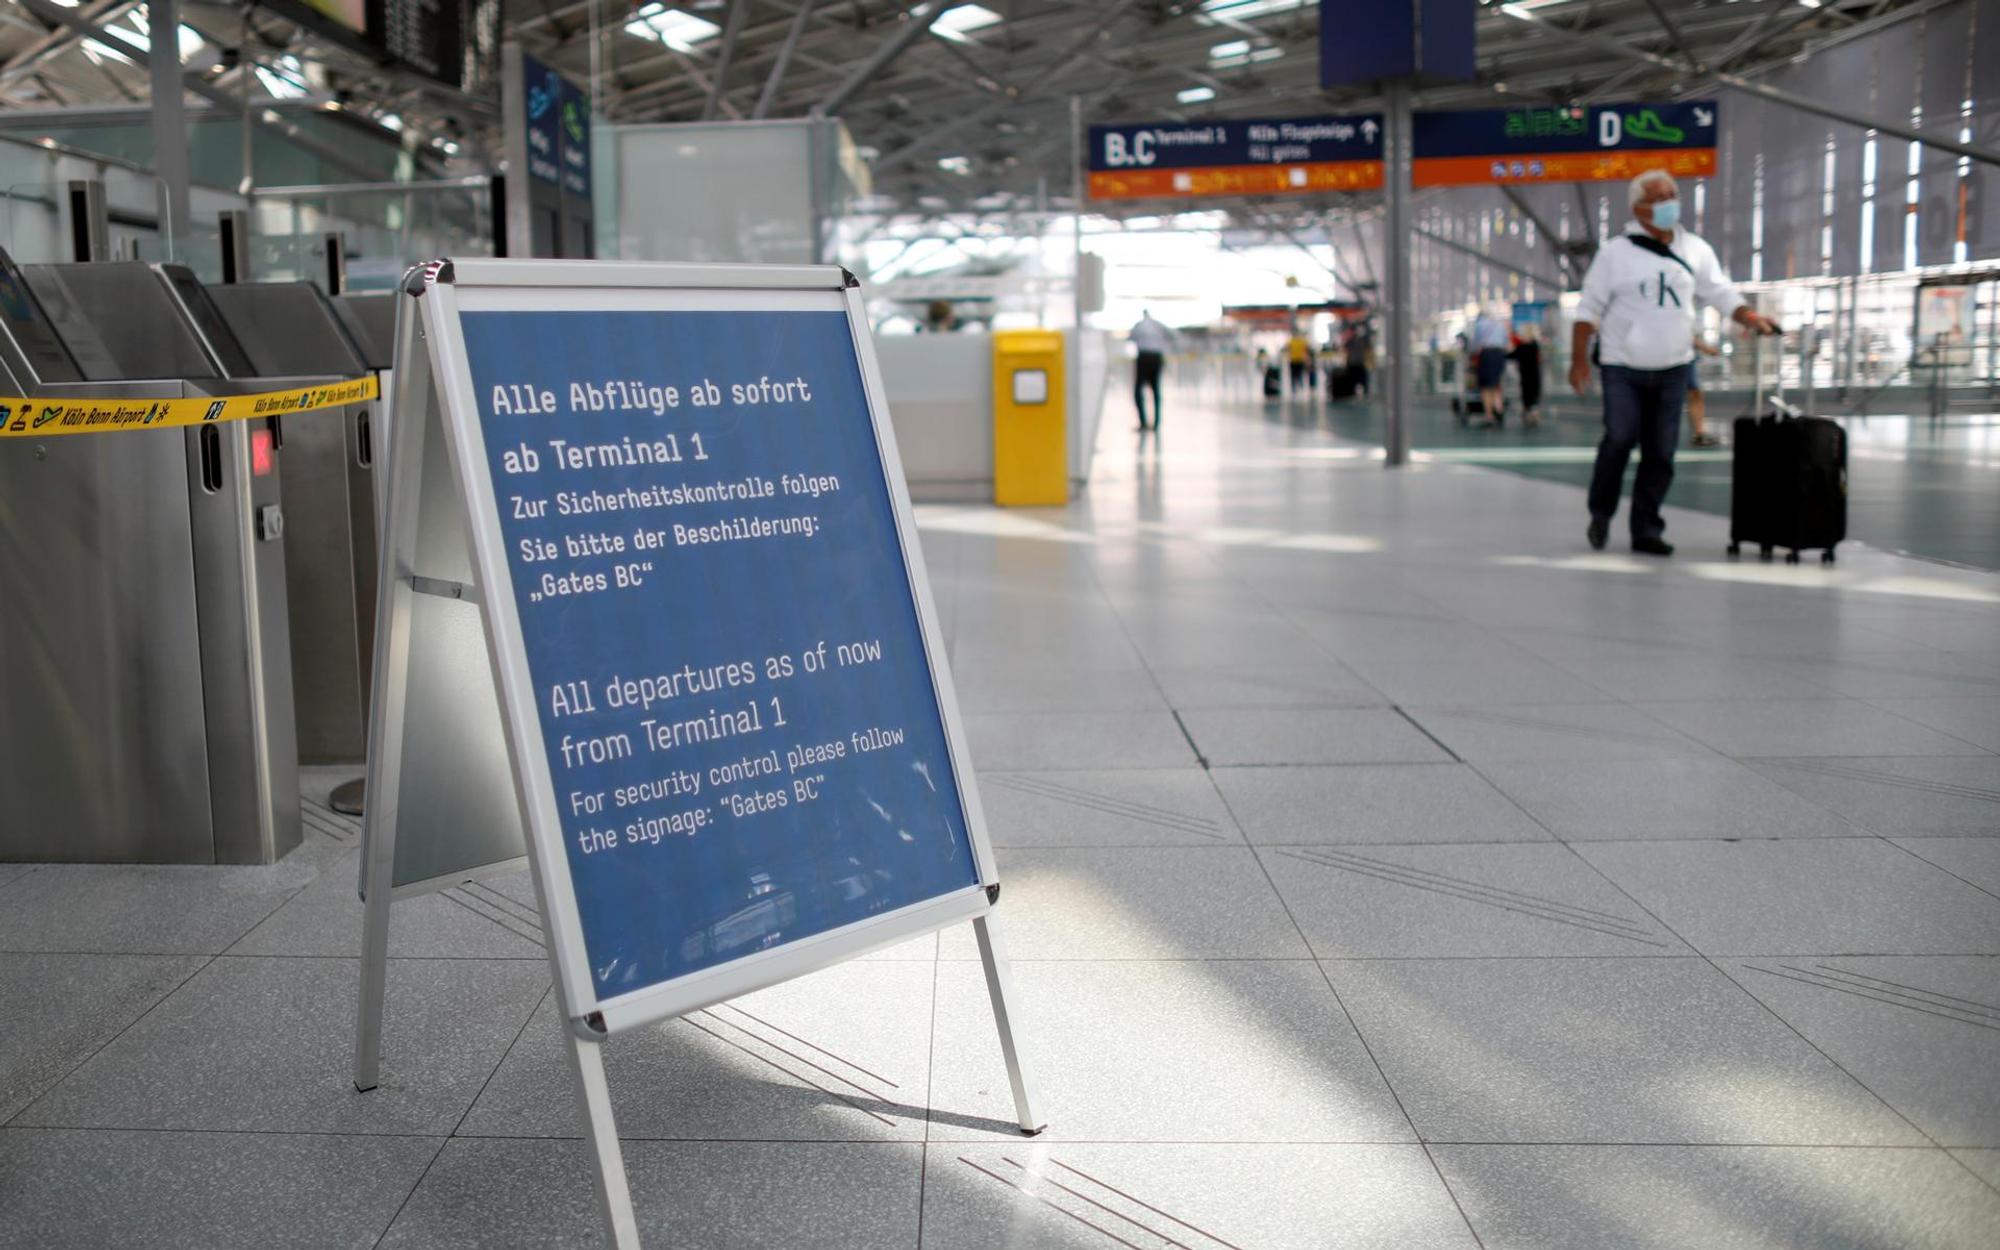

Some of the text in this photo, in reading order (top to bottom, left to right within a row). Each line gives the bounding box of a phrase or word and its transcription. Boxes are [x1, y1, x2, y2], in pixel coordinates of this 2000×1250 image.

[1599, 111, 1622, 146] D
[60, 407, 146, 428] Köln Bonn Airport
[492, 375, 812, 417] Alle Abflüge ab sofort
[503, 432, 709, 474] ab Terminal 1
[510, 473, 840, 520] Zur Sicherheitskontrolle folgen
[519, 516, 820, 562] Sie bitte der Beschilderung:
[552, 639, 881, 718] All departures as of now
[560, 696, 787, 768] from Terminal 1
[570, 727, 904, 816] For security control please follow
[578, 828, 618, 854] the
[626, 808, 713, 845] signage:
